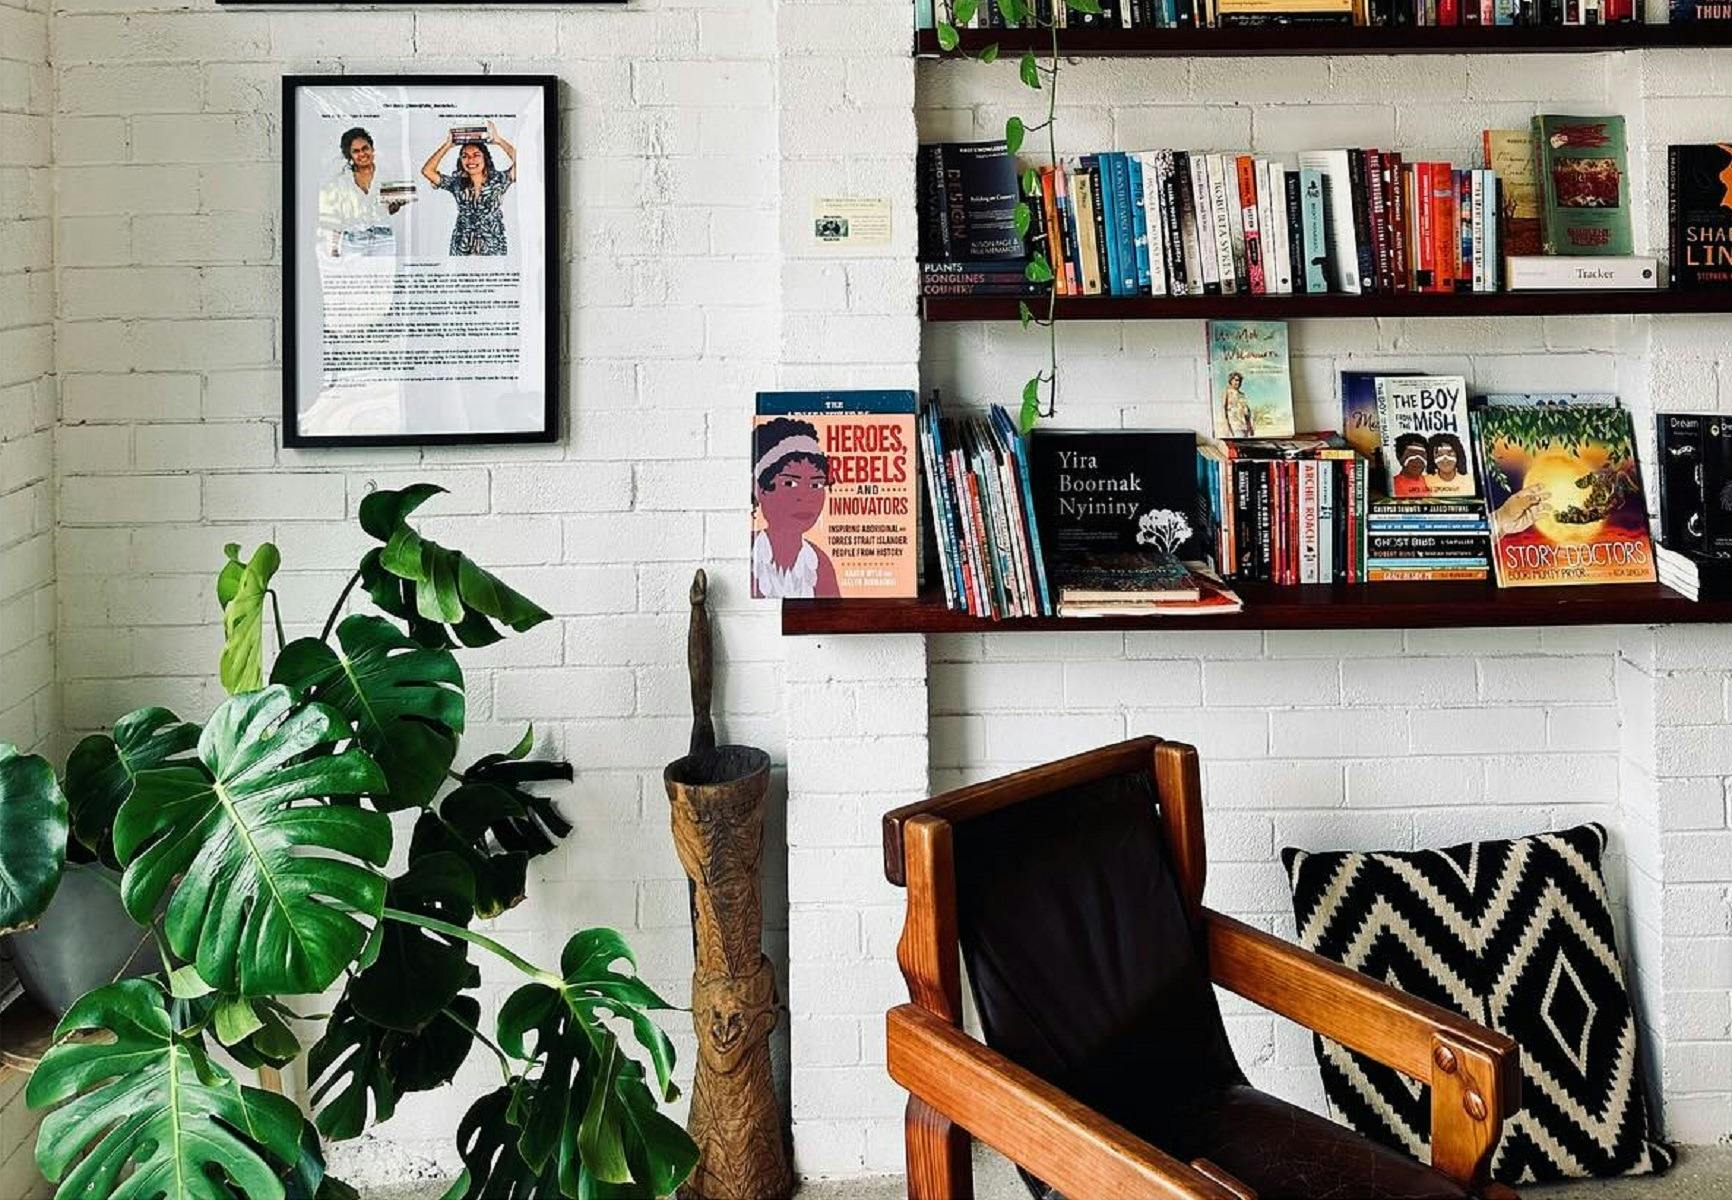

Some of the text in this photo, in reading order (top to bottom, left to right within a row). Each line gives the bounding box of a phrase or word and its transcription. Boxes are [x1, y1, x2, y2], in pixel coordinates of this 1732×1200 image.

[1214, 181, 1231, 276] ROBERTA SYKES
[924, 263, 963, 273] PLANTS
[1575, 268, 1615, 280] Tracker
[924, 273, 985, 284] SONGLINES
[924, 285, 974, 295] COUNTRY
[825, 401, 844, 409] THE
[1392, 386, 1460, 412] THE BOY
[1671, 417, 1699, 428] Dream
[826, 424, 908, 455] HEROES,
[1058, 451, 1098, 469] Yira
[828, 455, 907, 484] REBELS
[1059, 472, 1143, 492] Boornak
[856, 486, 879, 495] AND
[829, 497, 909, 516] INNOVATORS
[1059, 497, 1140, 520] Nyininy
[1304, 465, 1315, 543] ARCHIE ROACH
[829, 525, 860, 533] INSPIRING
[828, 536, 908, 545] TORRES STRAIT ISLANDER
[1262, 530, 1270, 563] INDIANS
[1374, 537, 1409, 547] GHOST
[1411, 537, 1436, 546] BIRD
[832, 548, 904, 557] PEOPLE FROM HISTORY
[1505, 541, 1647, 568] STORY DOCTORS
[1561, 567, 1586, 579] PRYOR
